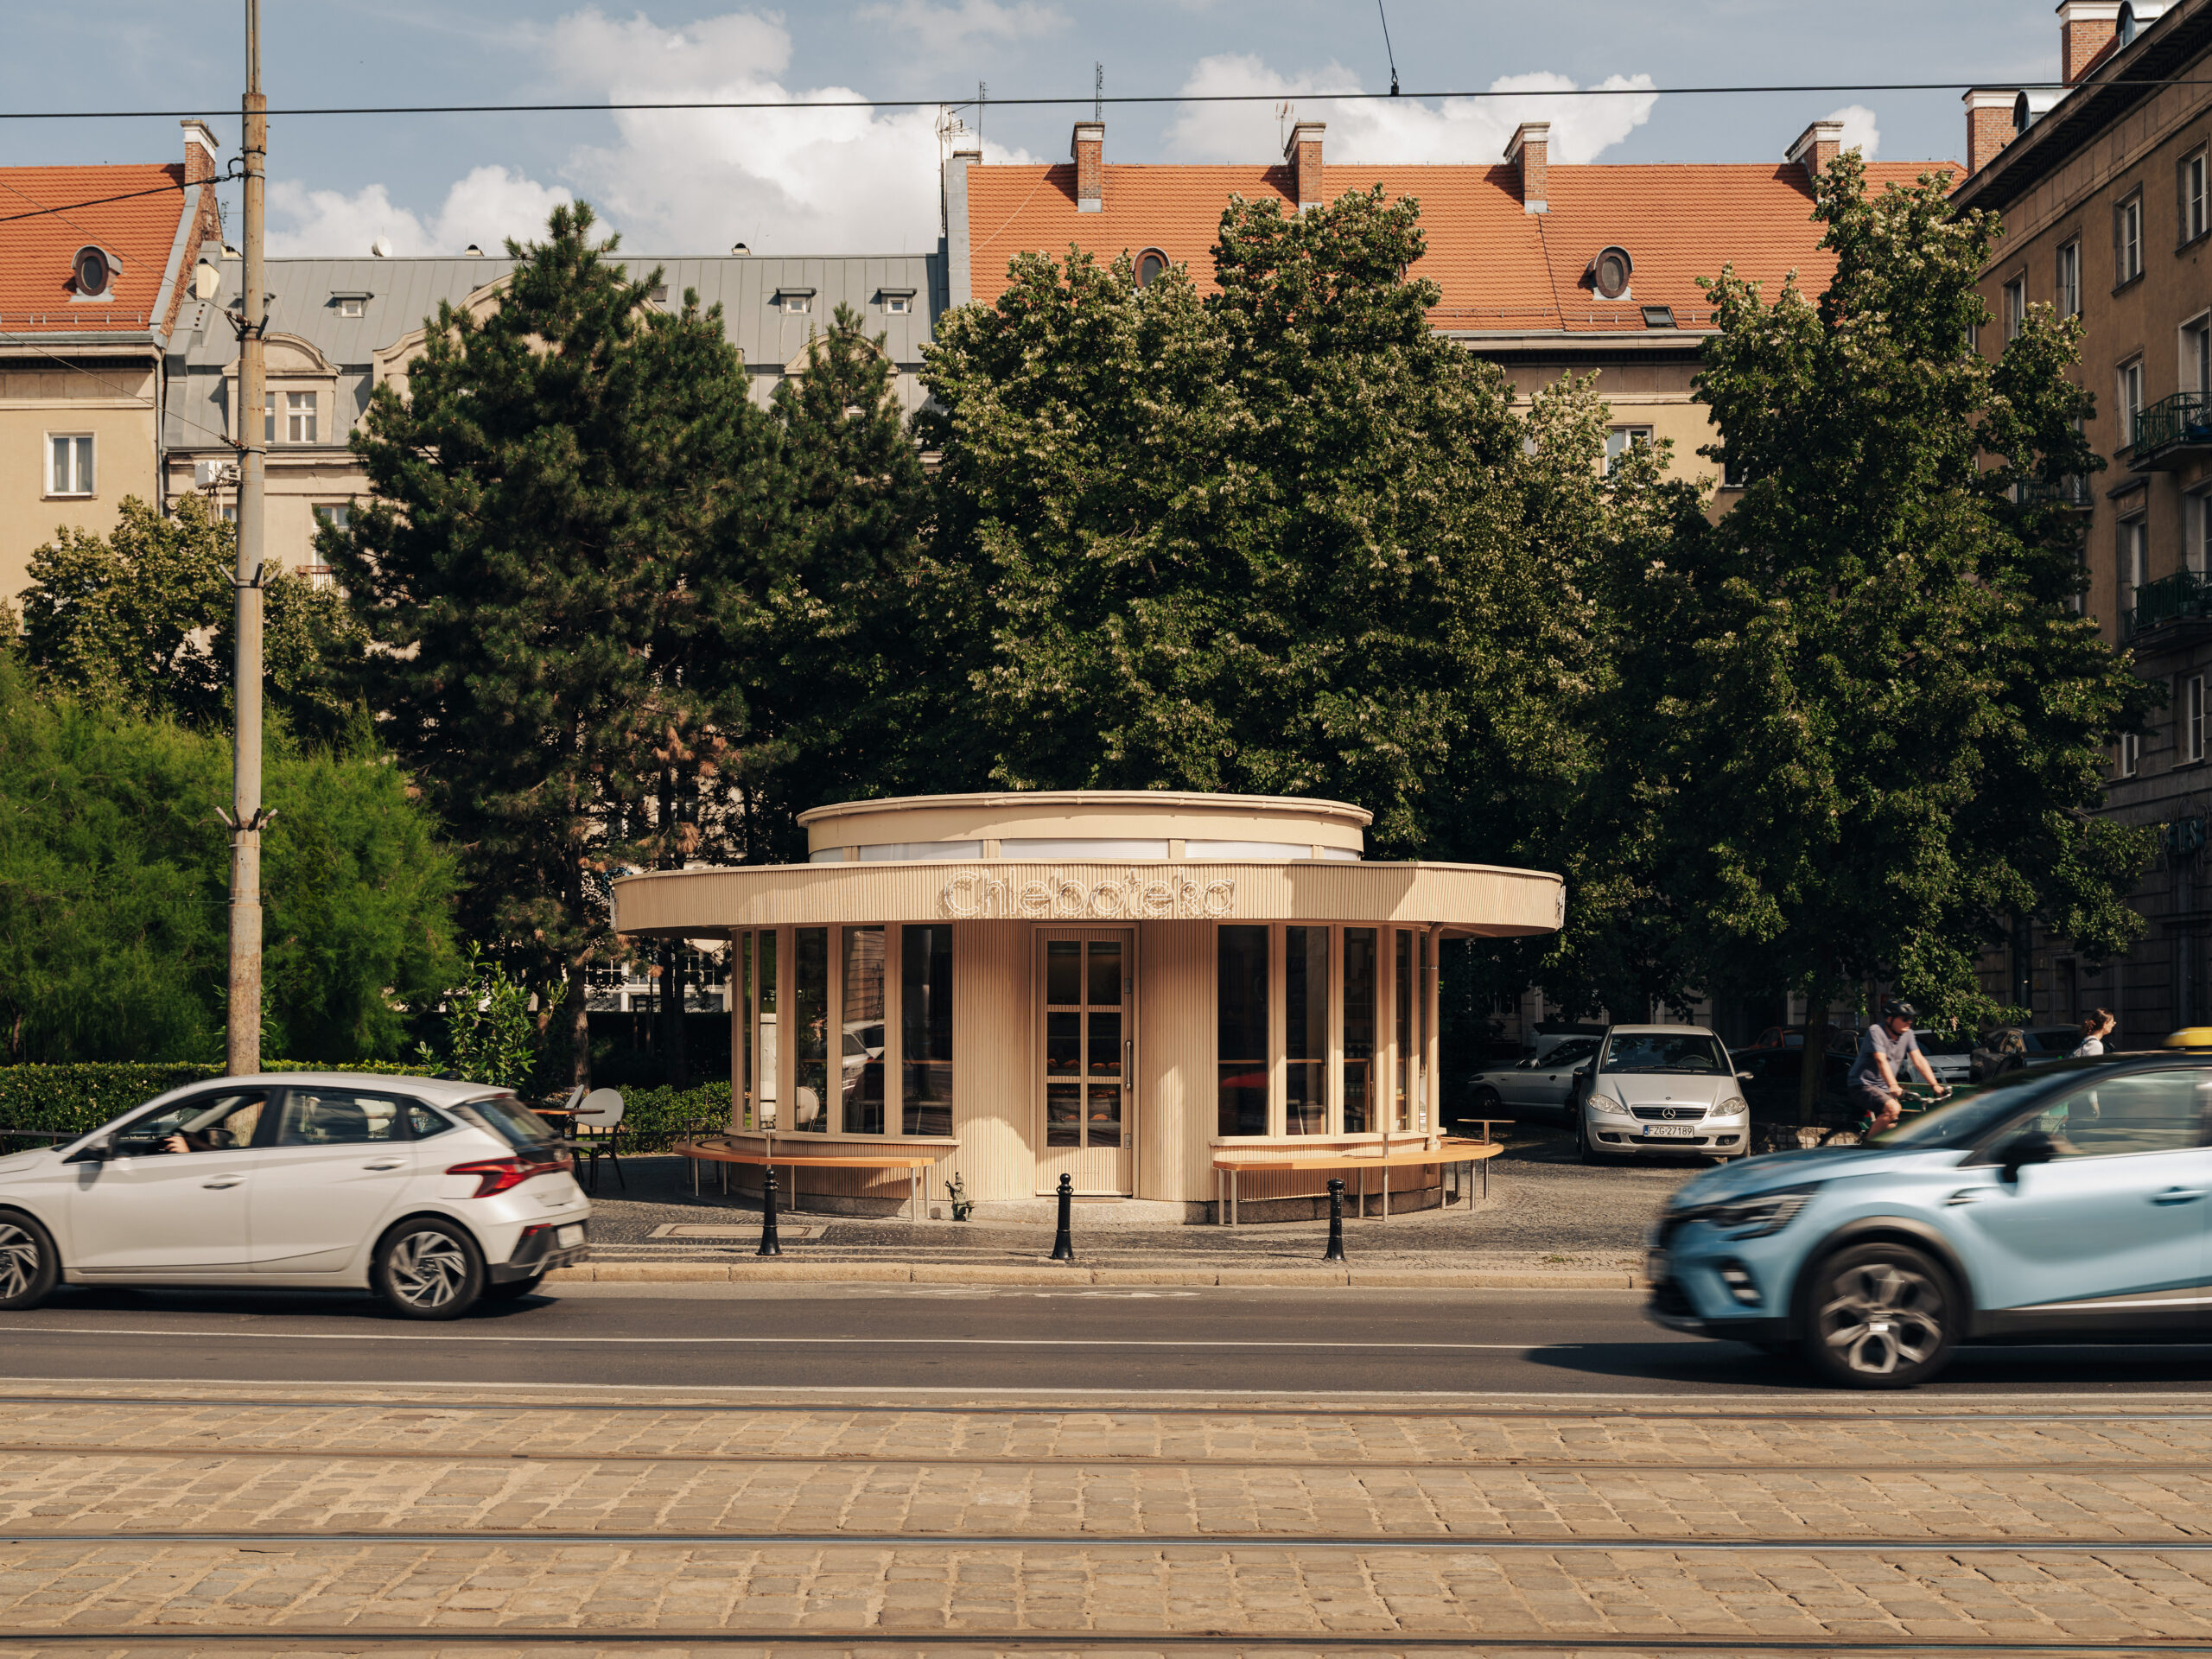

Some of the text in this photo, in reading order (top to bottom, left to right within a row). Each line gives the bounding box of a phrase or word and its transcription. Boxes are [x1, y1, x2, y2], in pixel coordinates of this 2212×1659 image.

[944, 868, 1236, 916] Chleboteka
[1649, 1126, 1665, 1135] FZG
[1668, 1127, 1693, 1135] 27189
